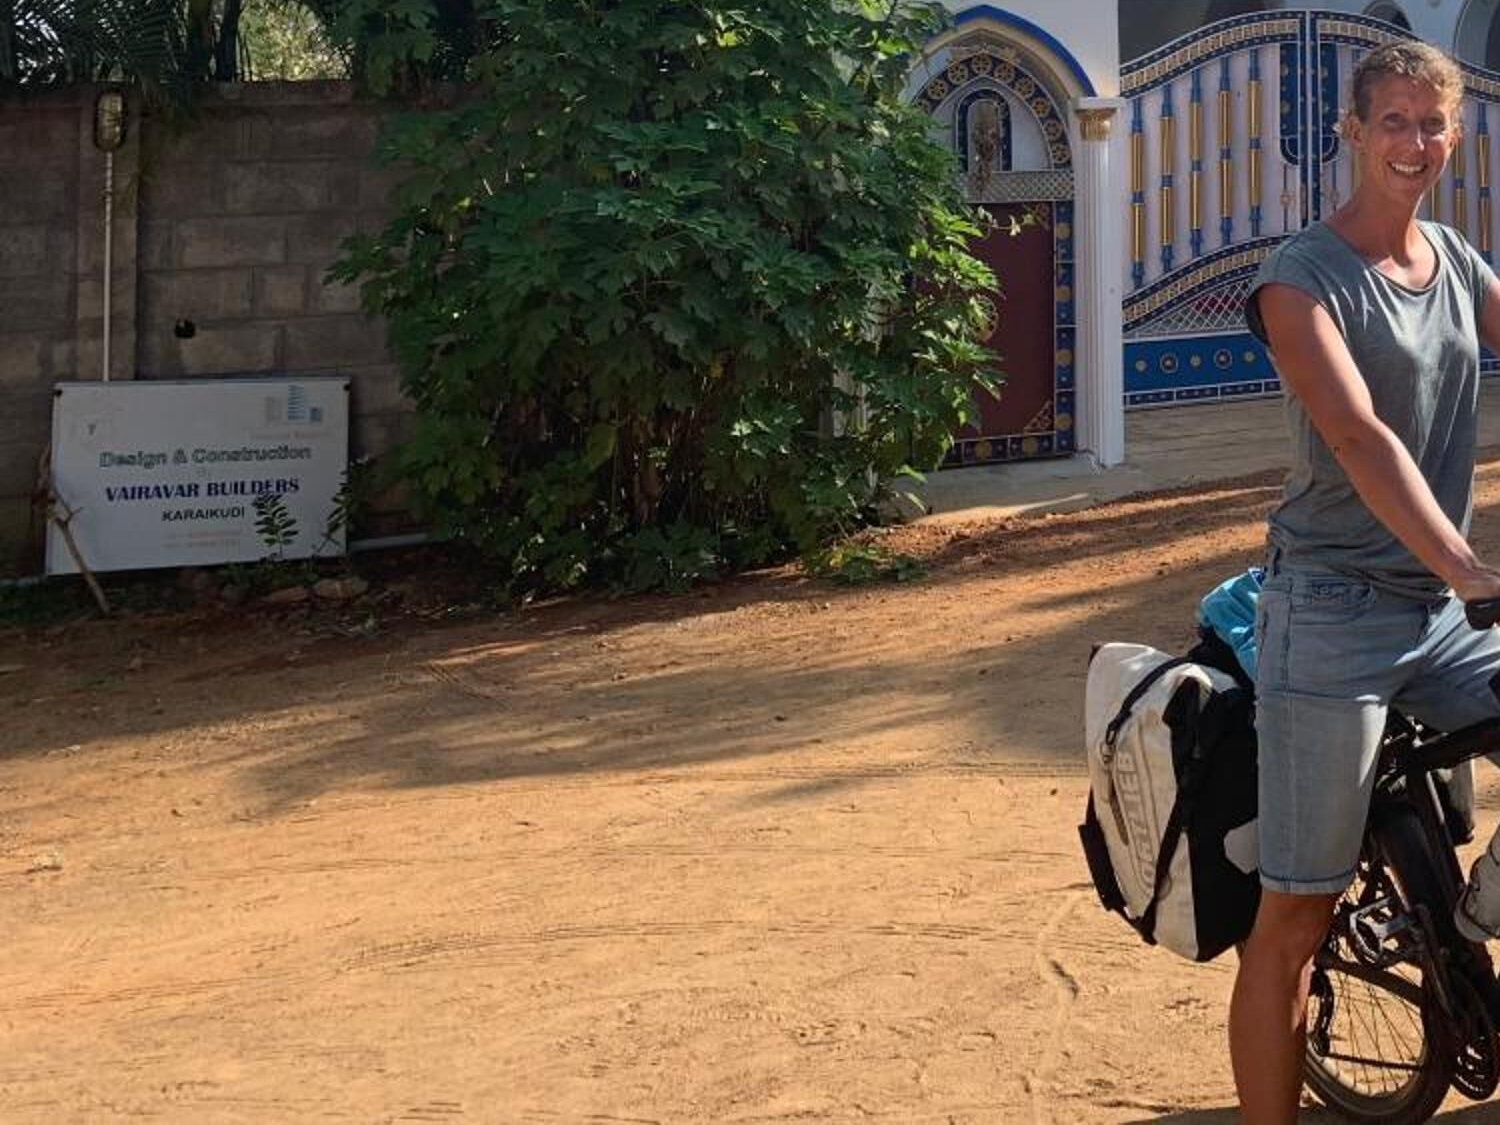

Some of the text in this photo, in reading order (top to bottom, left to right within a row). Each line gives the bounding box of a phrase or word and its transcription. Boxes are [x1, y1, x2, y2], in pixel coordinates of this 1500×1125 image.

[99, 444, 312, 469] Design & Construction
[105, 477, 301, 503] VAIRAVAR BUILDERS
[161, 506, 245, 522] KARAIKUDI
[1117, 752, 1154, 886] ORTLIEB
